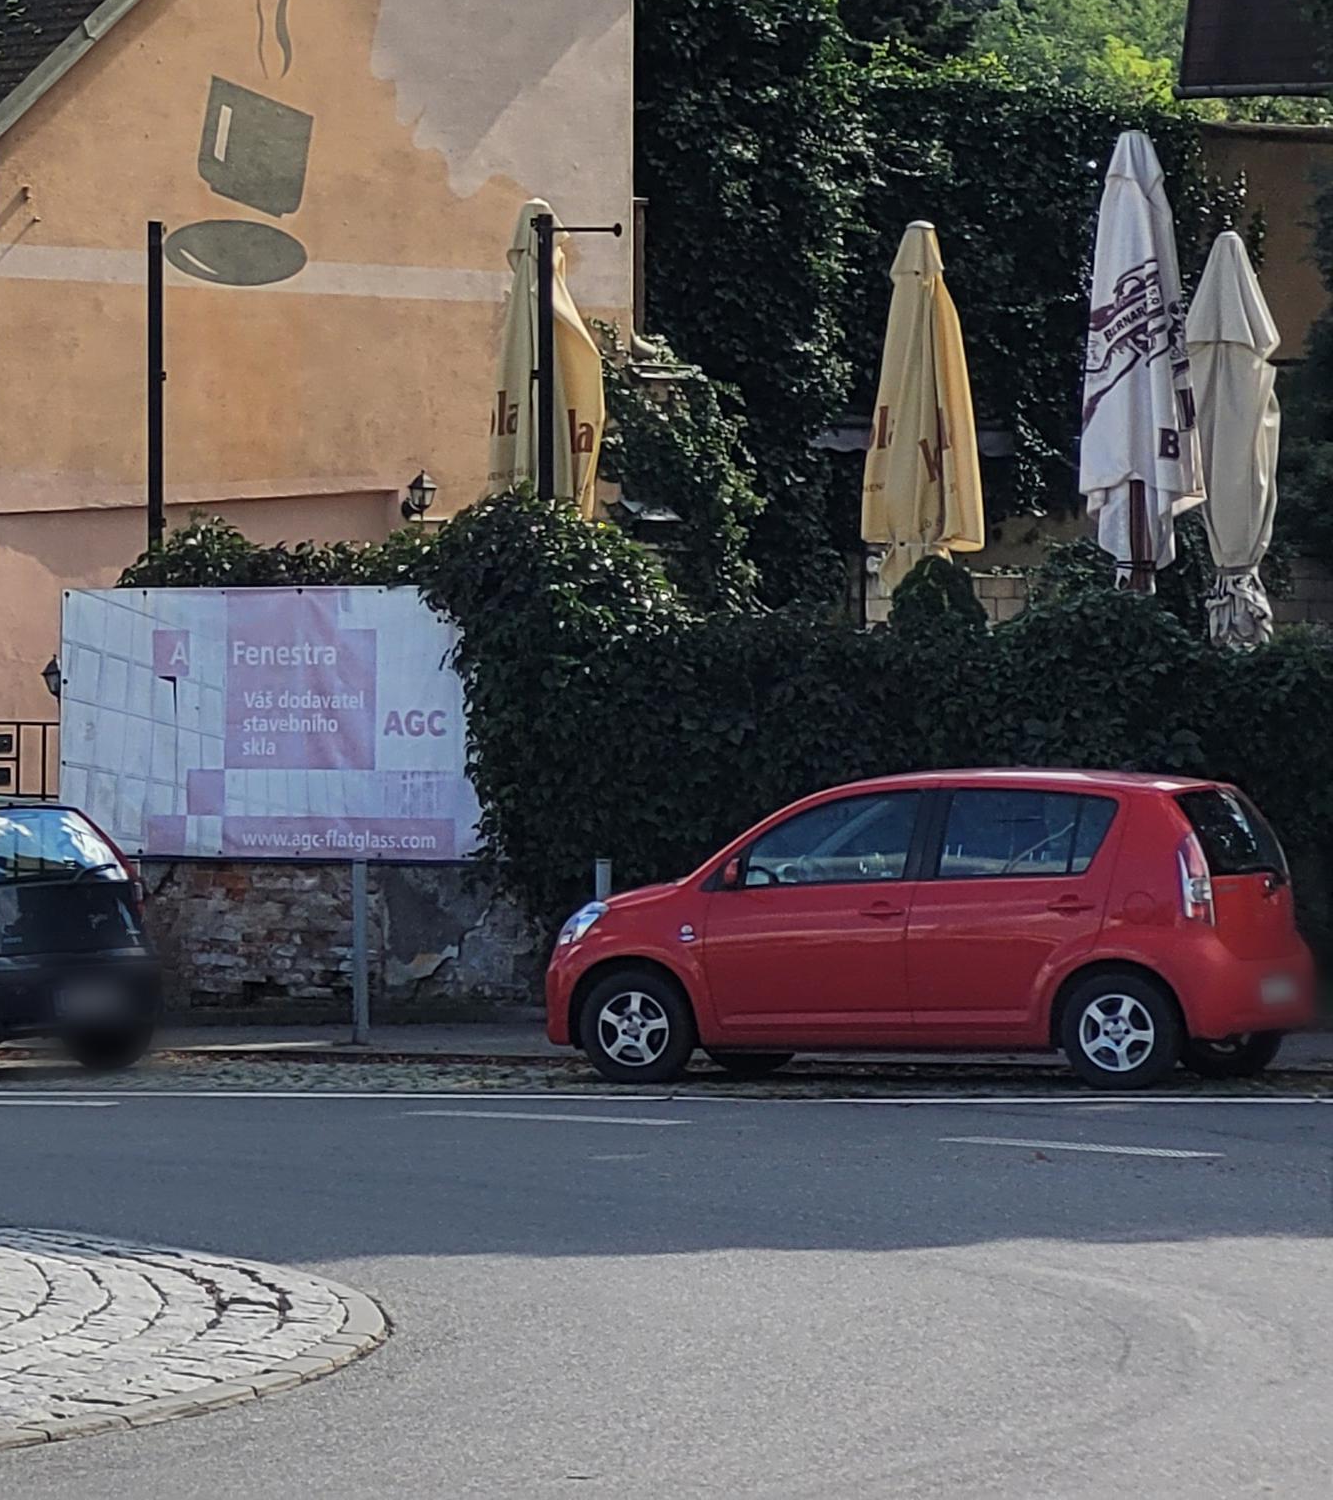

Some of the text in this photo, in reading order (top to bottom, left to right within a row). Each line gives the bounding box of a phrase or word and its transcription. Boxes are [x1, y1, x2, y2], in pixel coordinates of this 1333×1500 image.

[1104, 301, 1148, 343] BERNAR
[169, 641, 189, 665] A
[233, 641, 337, 666] Fenestra
[243, 690, 364, 709] Váš dodavatel
[242, 713, 338, 733] stavebního
[384, 709, 447, 737] AGC
[242, 737, 276, 756] skla
[242, 829, 436, 850] www.agc-flatglass.com
